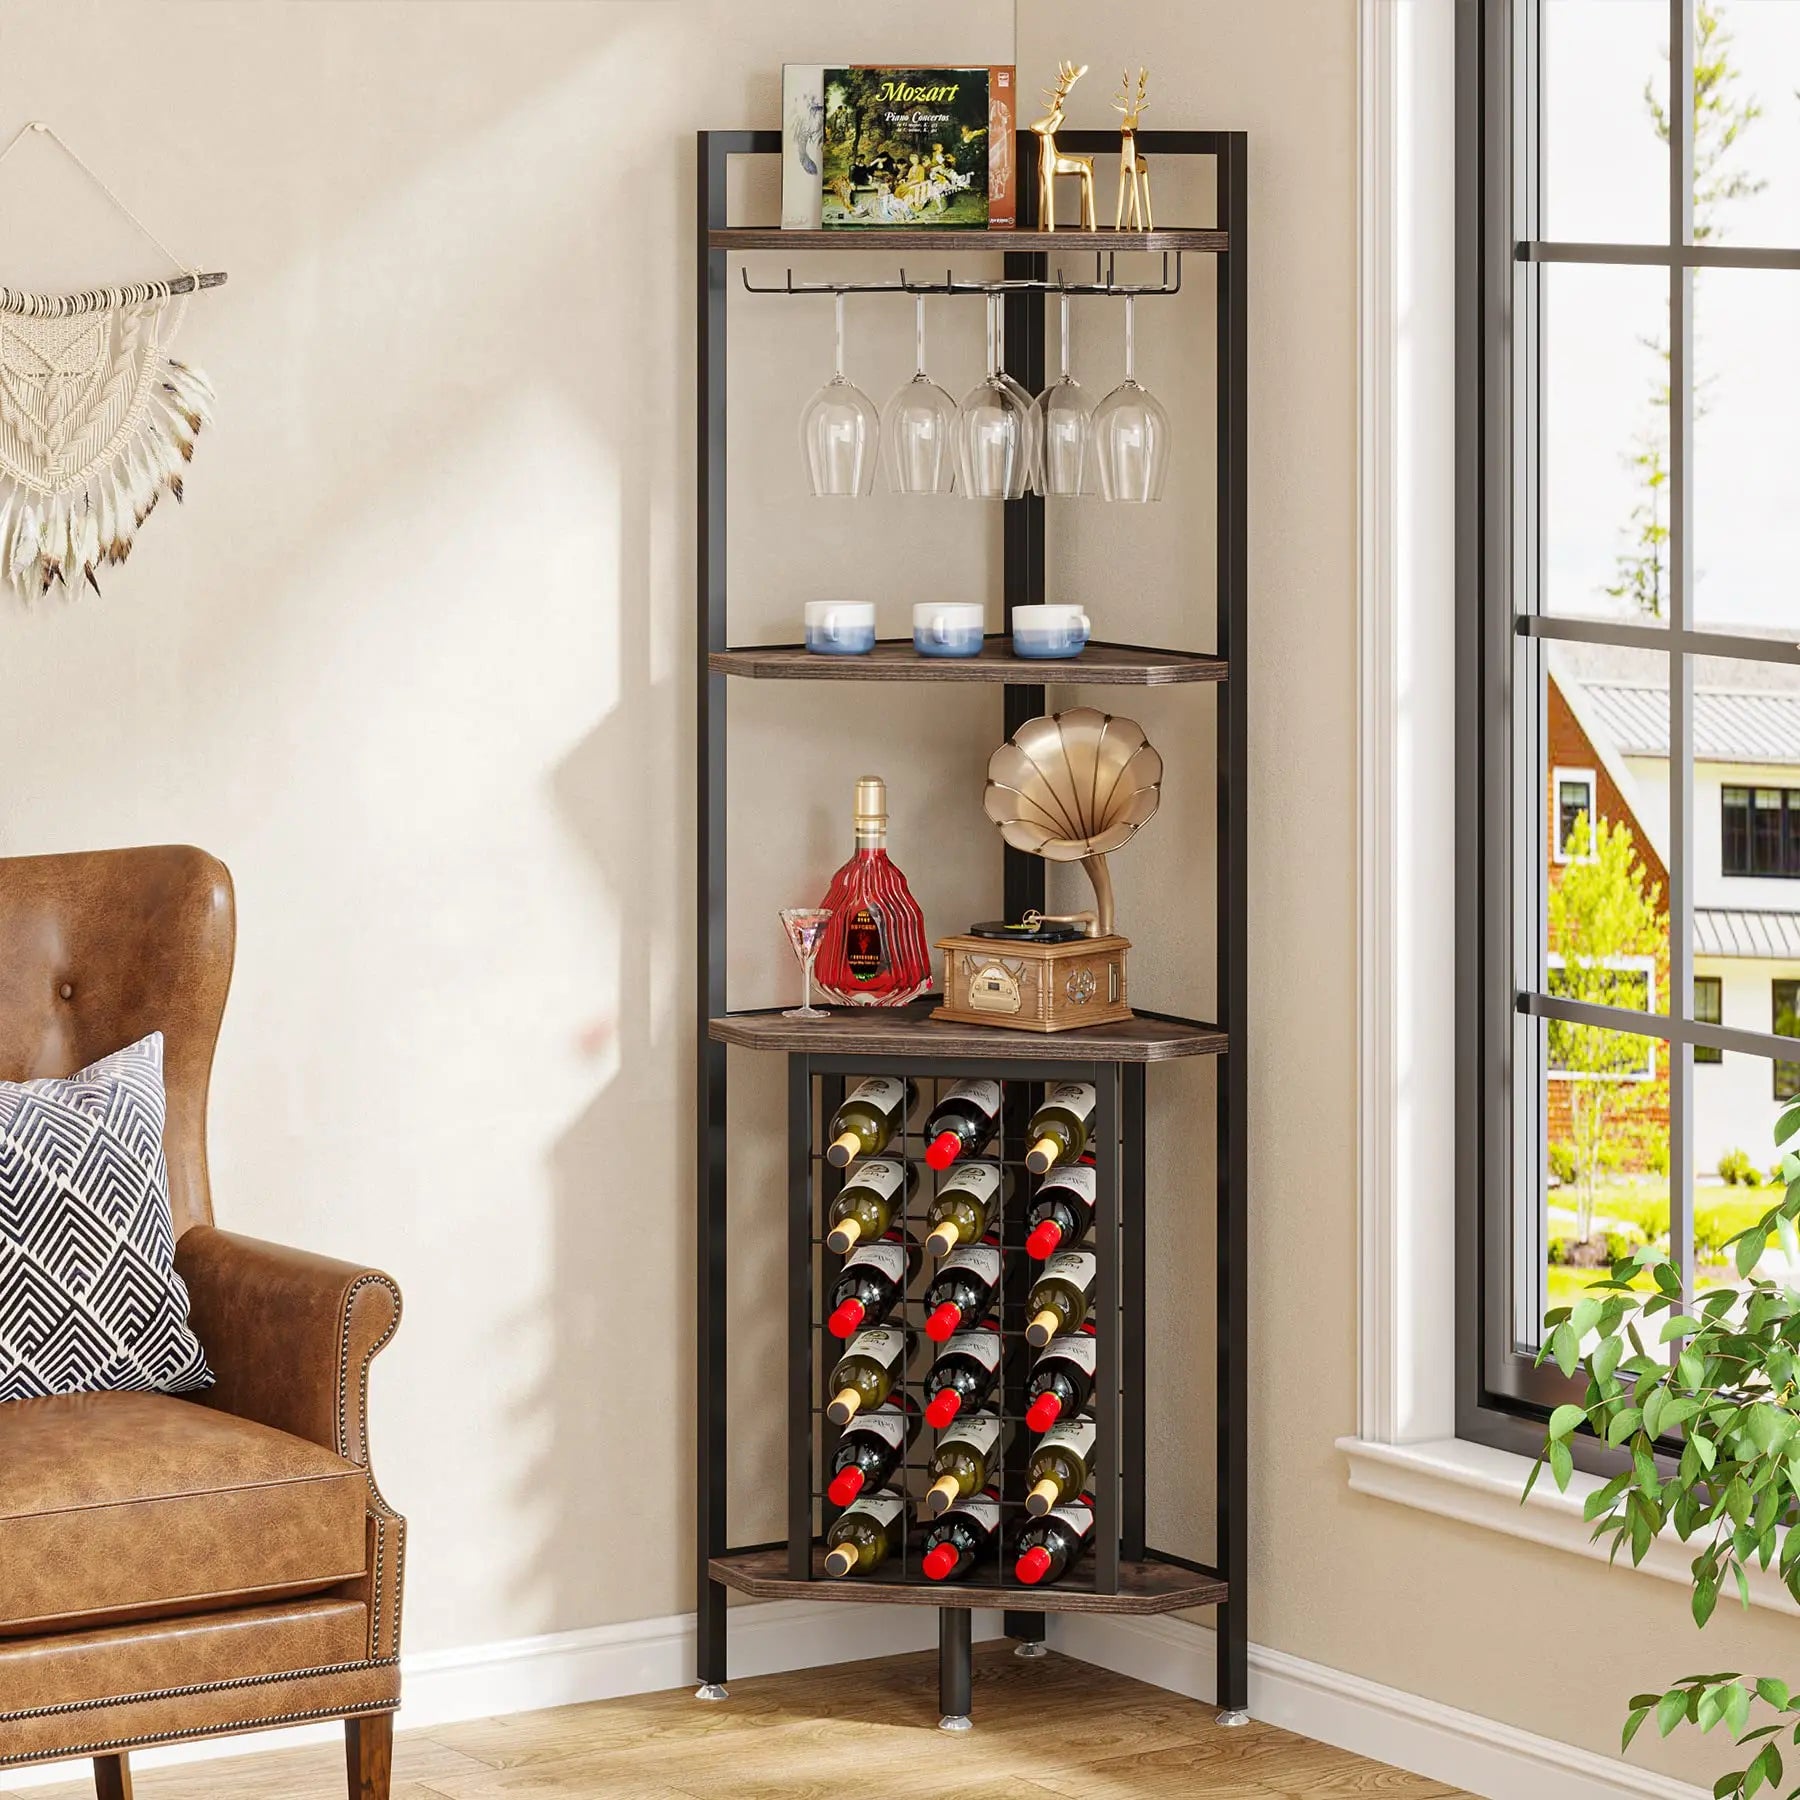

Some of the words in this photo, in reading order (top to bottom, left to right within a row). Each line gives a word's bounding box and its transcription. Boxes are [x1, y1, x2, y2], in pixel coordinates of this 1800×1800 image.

[875, 82, 960, 102] Mozart
[884, 111, 910, 122] Piano
[912, 111, 950, 123] Concertos
